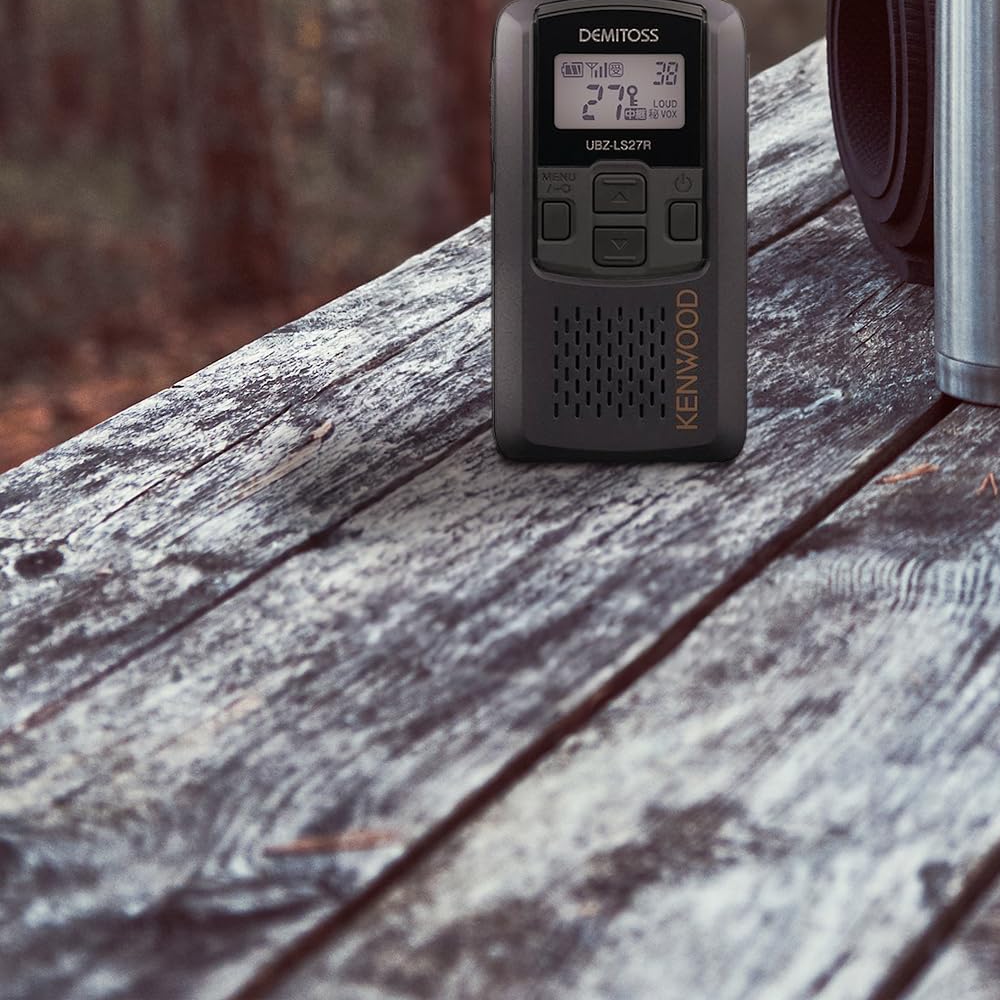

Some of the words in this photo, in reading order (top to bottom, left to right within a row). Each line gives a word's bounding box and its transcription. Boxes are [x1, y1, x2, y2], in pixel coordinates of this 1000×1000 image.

[579, 28, 659, 42] DEMITOSS
[653, 61, 678, 85] 38
[582, 84, 624, 121] 27
[653, 99, 678, 109] LOUD
[660, 110, 678, 119] VOX
[585, 139, 652, 151] UBZ-LS27R
[675, 288, 699, 430] KENWOOD
